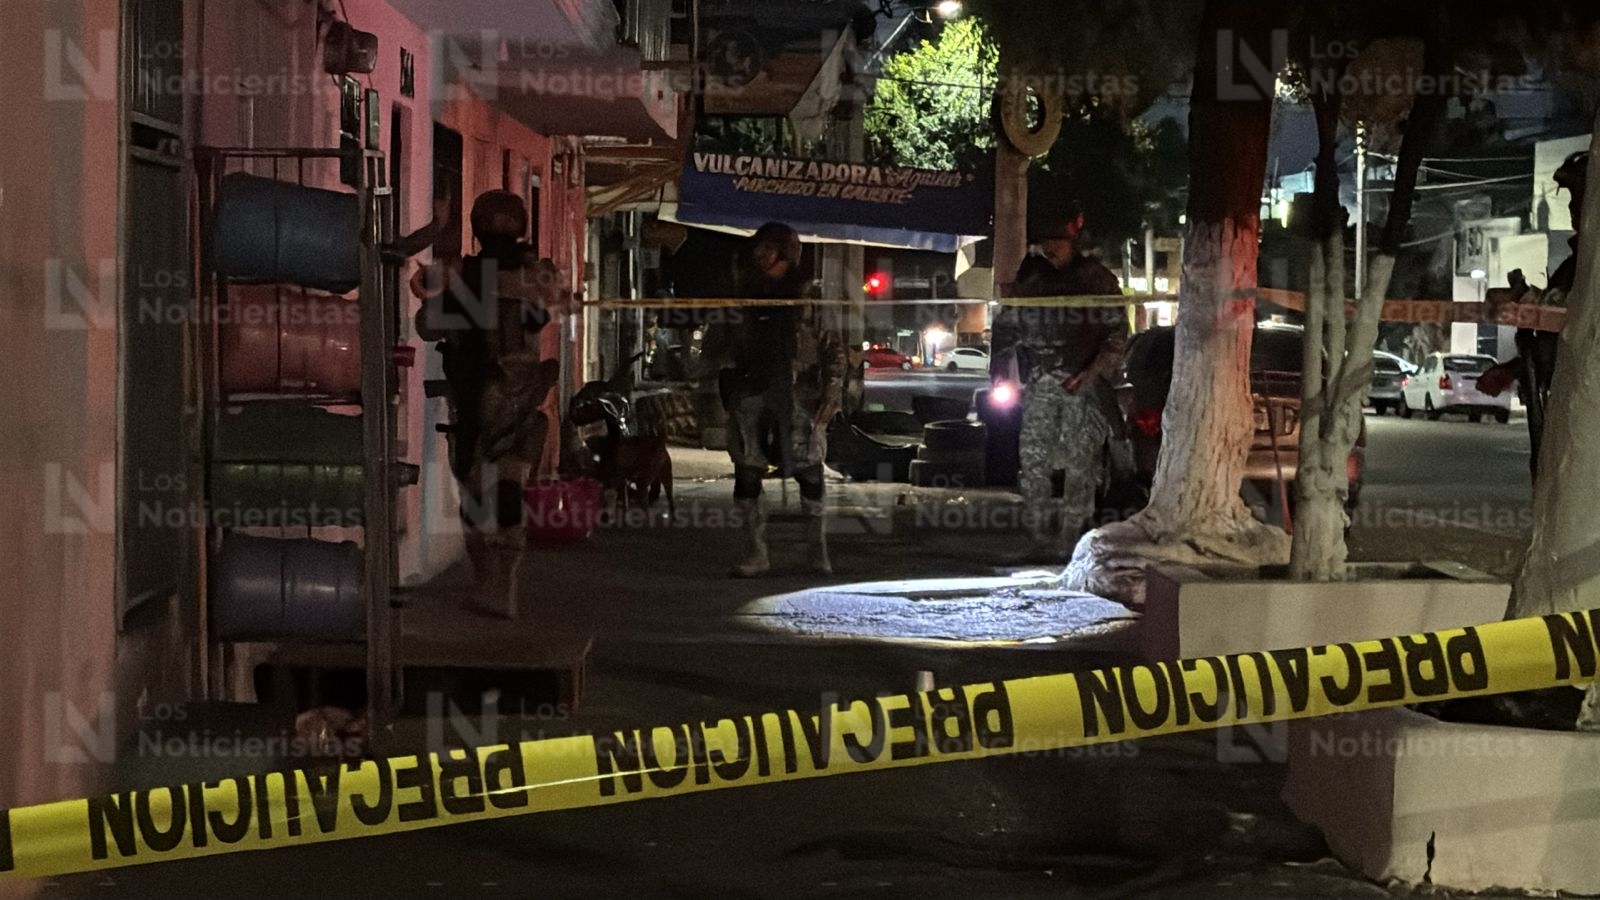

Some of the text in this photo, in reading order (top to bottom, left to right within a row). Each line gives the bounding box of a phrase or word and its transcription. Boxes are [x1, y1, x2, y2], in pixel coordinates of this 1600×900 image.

[693, 152, 882, 186] VULCANIZADORA
[598, 680, 1014, 797] PRECAUCION
[1077, 625, 1488, 738] PRECAUCION
[89, 743, 529, 860] PRECAUCION
